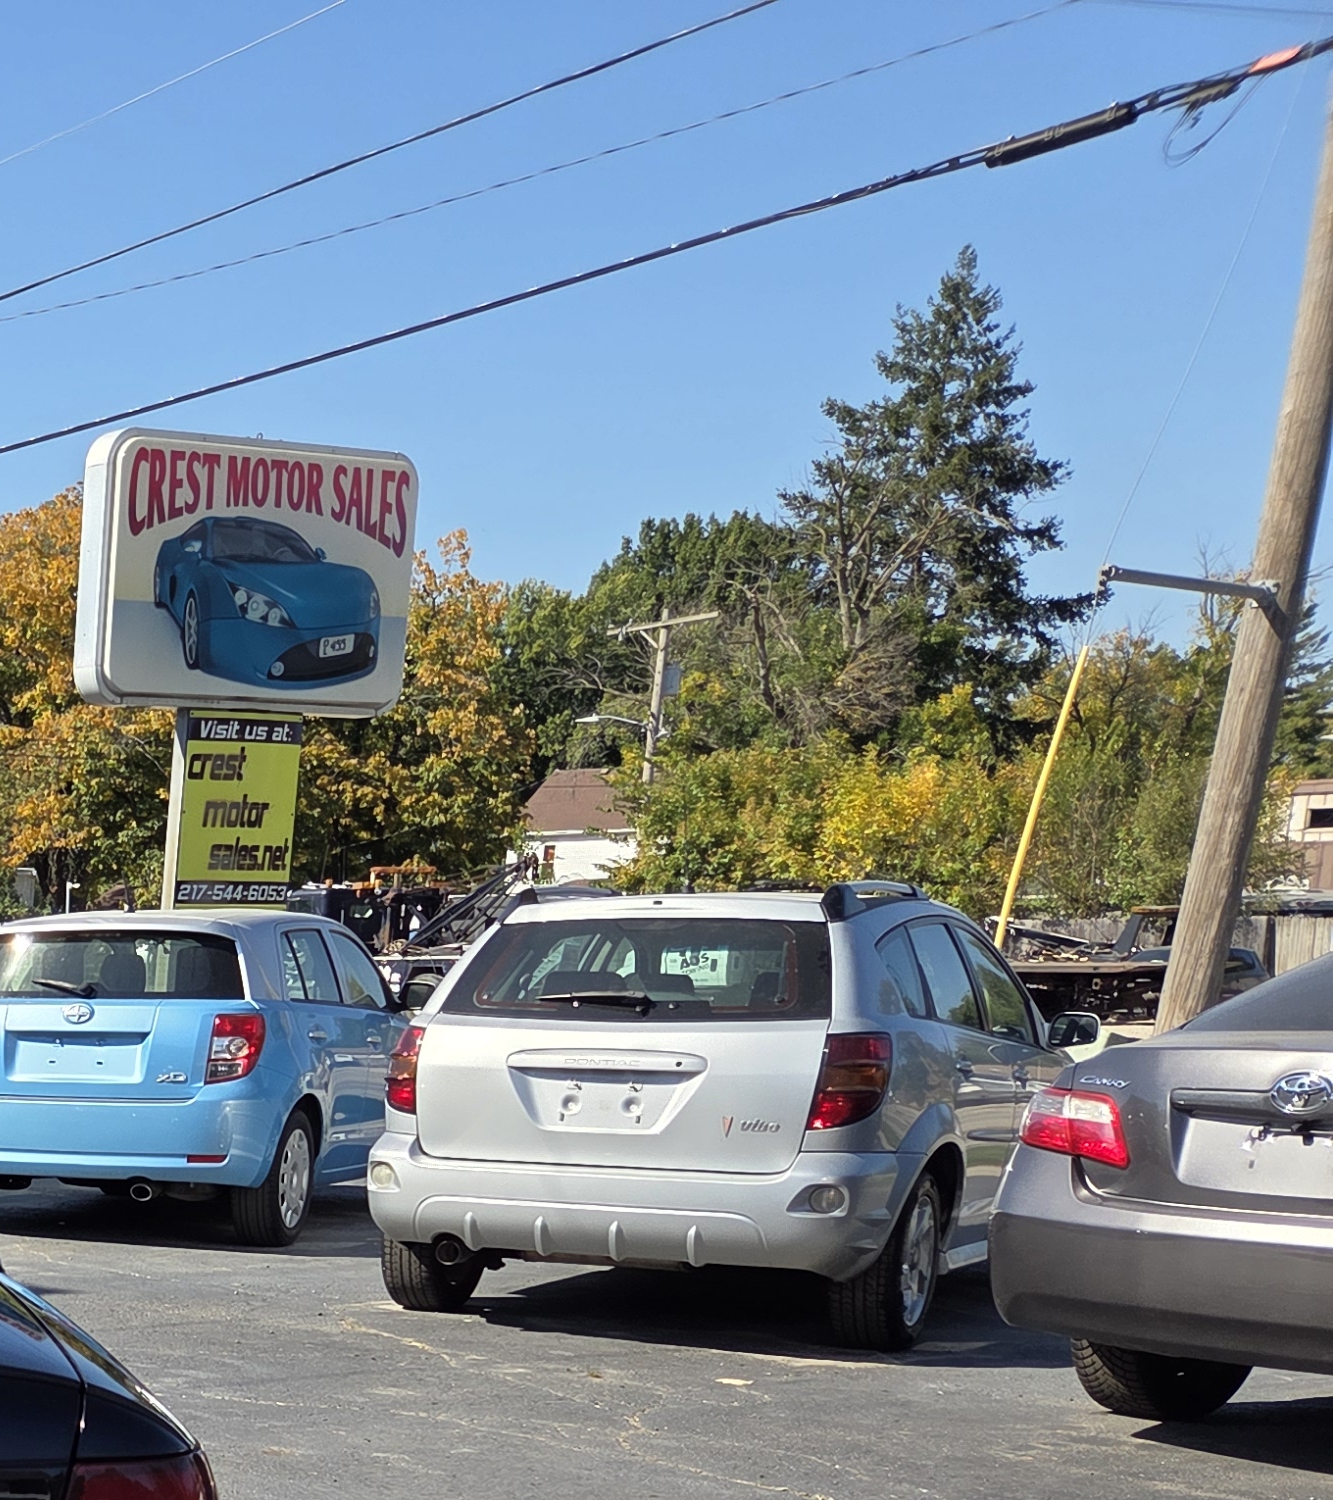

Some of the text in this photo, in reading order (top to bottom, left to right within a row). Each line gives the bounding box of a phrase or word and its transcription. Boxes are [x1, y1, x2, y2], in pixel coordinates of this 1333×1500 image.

[128, 446, 410, 558] CREST MOTOR SALES
[200, 720, 293, 741] Visit us at:
[187, 746, 247, 781] crest
[202, 794, 270, 828] motor
[207, 836, 289, 871] sales.net
[177, 884, 287, 901] 217-544-6053
[564, 1058, 641, 1067] PONTIAC
